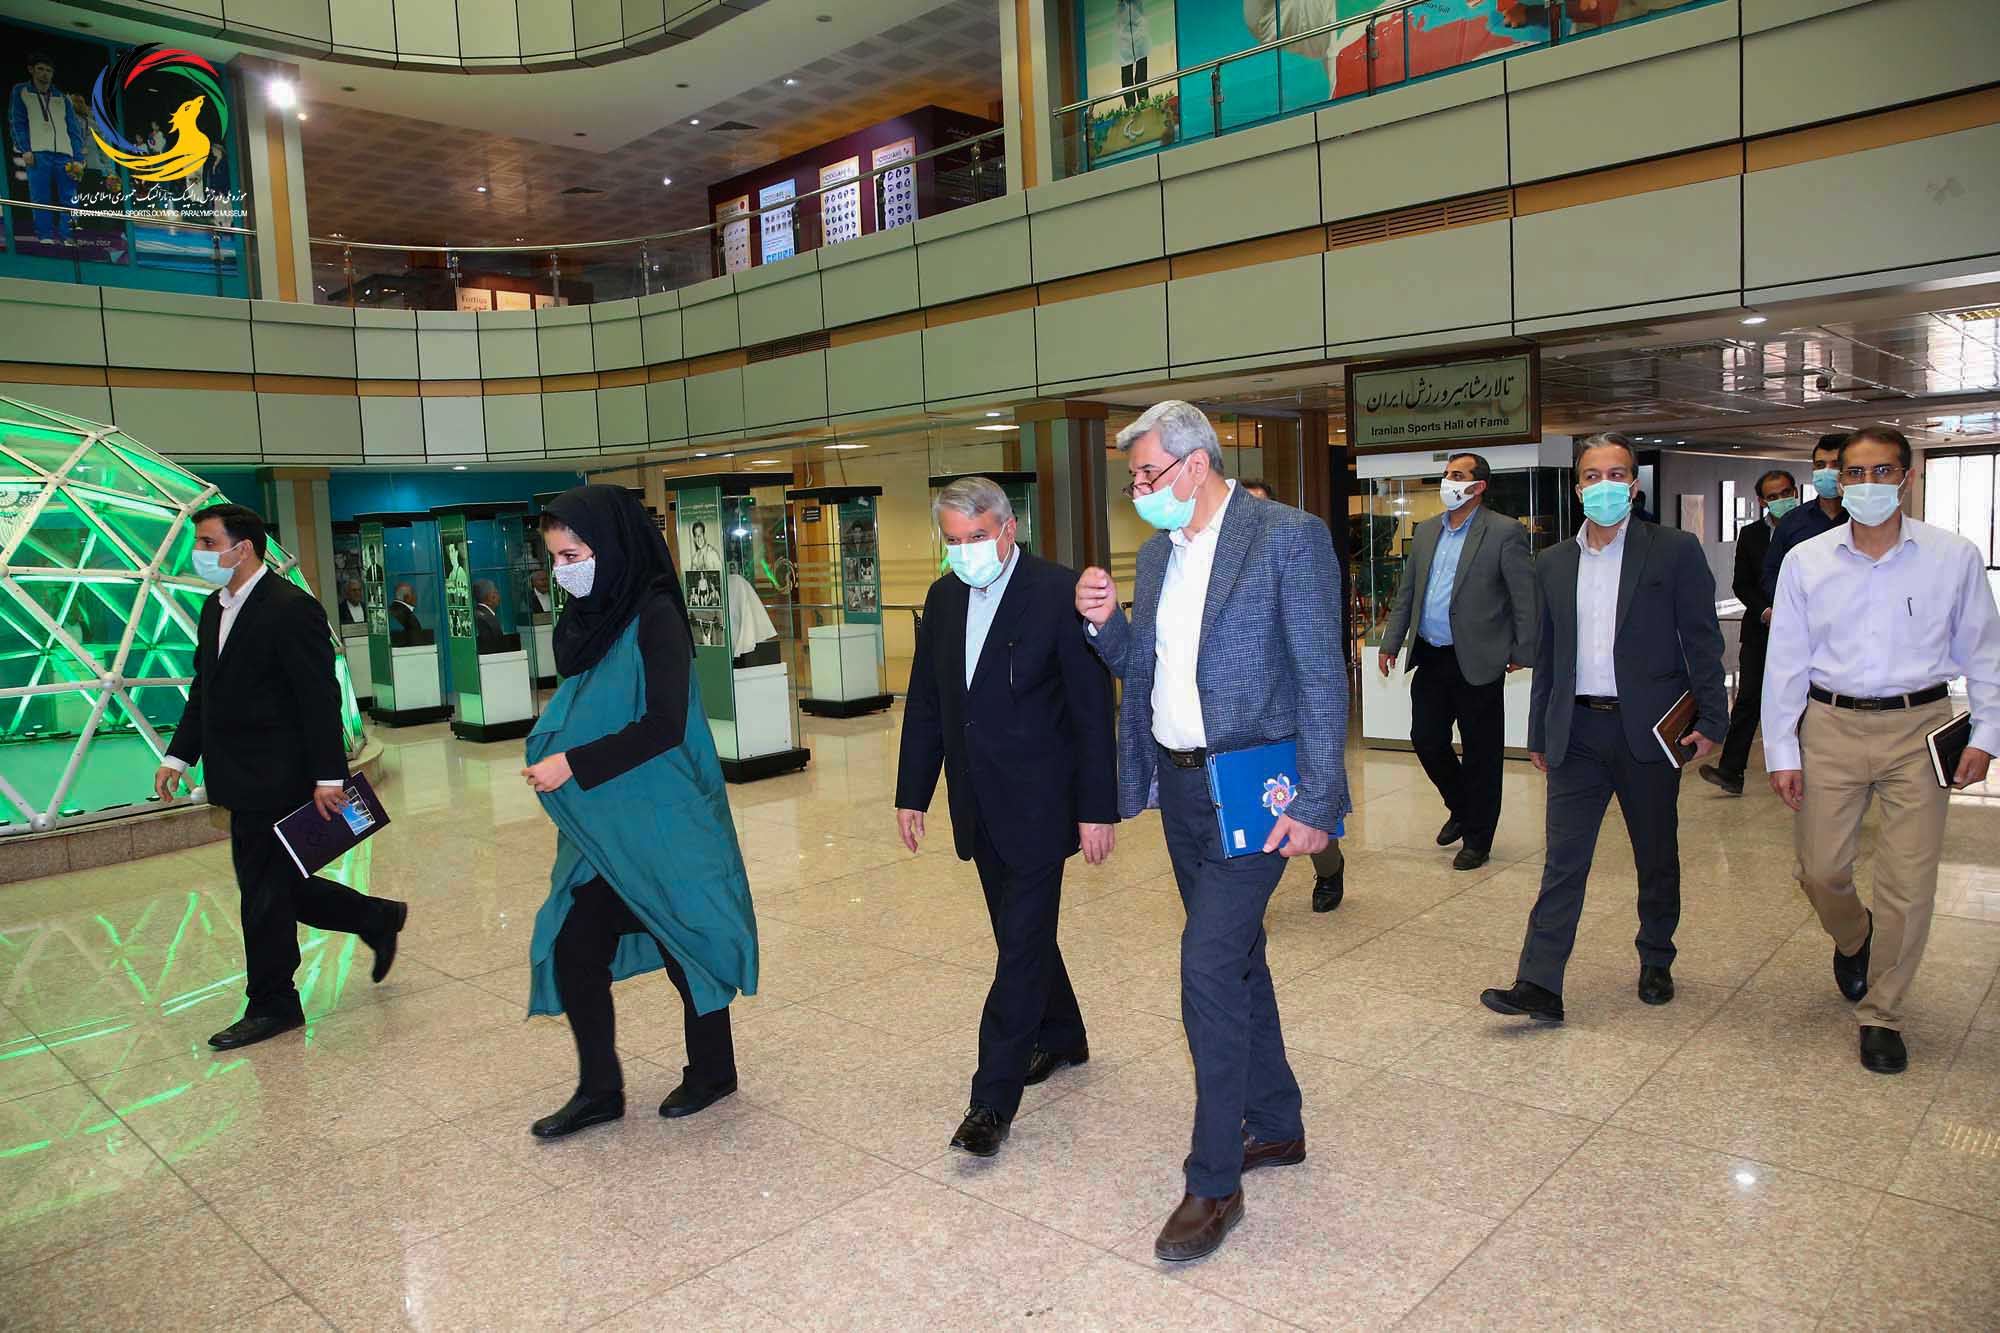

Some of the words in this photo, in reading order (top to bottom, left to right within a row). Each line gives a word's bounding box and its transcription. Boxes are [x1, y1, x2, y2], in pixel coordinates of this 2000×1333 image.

[1405, 376, 1448, 410] ورزش
[1442, 375, 1487, 409] مشاهیر
[1484, 375, 1515, 398] تالار
[1366, 389, 1405, 413] ایران
[1371, 424, 1405, 436] Iranian
[1407, 421, 1441, 435] Sports
[1443, 418, 1464, 431] Hall
[1466, 417, 1477, 429] of
[1480, 416, 1510, 428] Fame
